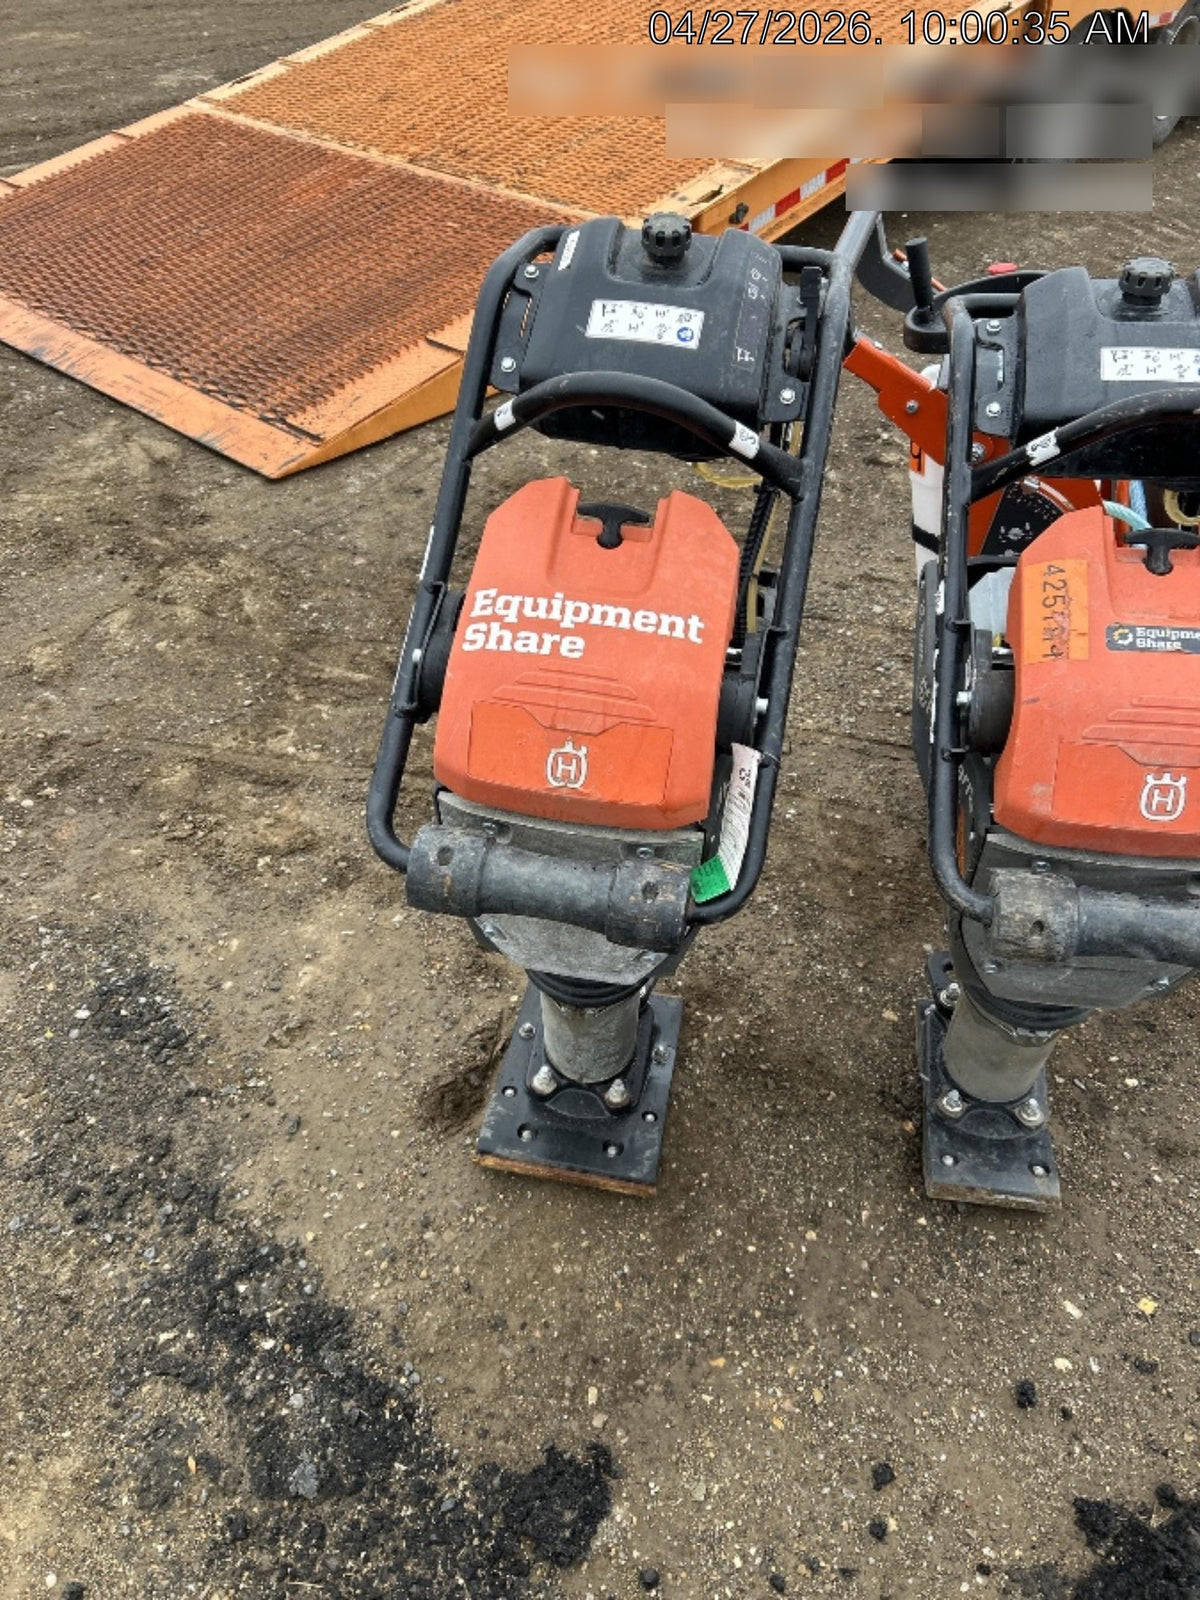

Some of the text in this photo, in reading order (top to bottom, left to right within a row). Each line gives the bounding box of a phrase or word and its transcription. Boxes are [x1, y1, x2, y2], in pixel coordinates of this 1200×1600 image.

[470, 588, 705, 644] Equipment
[462, 621, 586, 659] Share
[1135, 638, 1182, 650] Share
